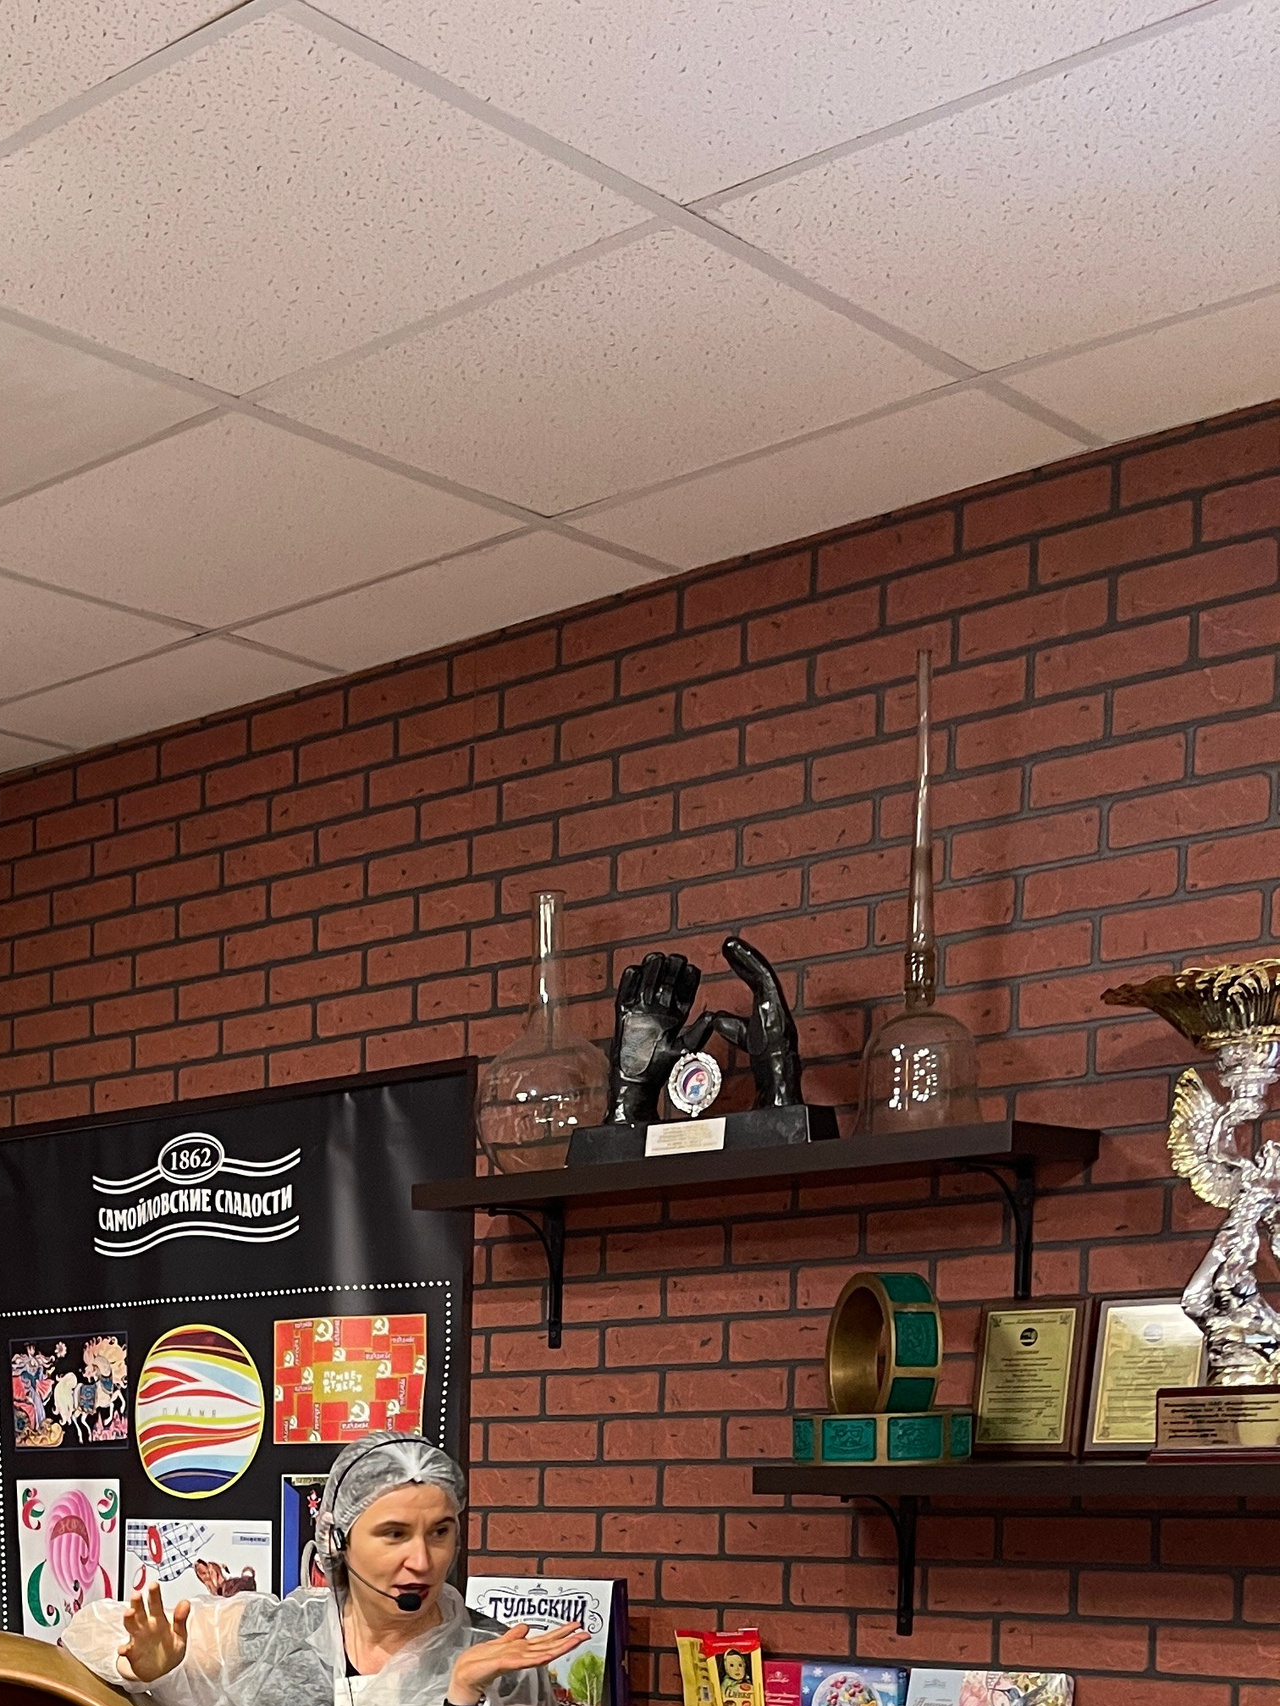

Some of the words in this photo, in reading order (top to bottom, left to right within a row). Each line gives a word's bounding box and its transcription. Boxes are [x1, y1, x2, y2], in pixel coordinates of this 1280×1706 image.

[170, 1147, 212, 1171] 1862
[98, 1188, 212, 1232] САМОЙЛОВСКИЕ
[215, 1184, 293, 1219] СЛАДОСТИ
[323, 1370, 363, 1383] ПРИВЕТ
[489, 1595, 587, 1630] ТУЛЬСКИЙ
